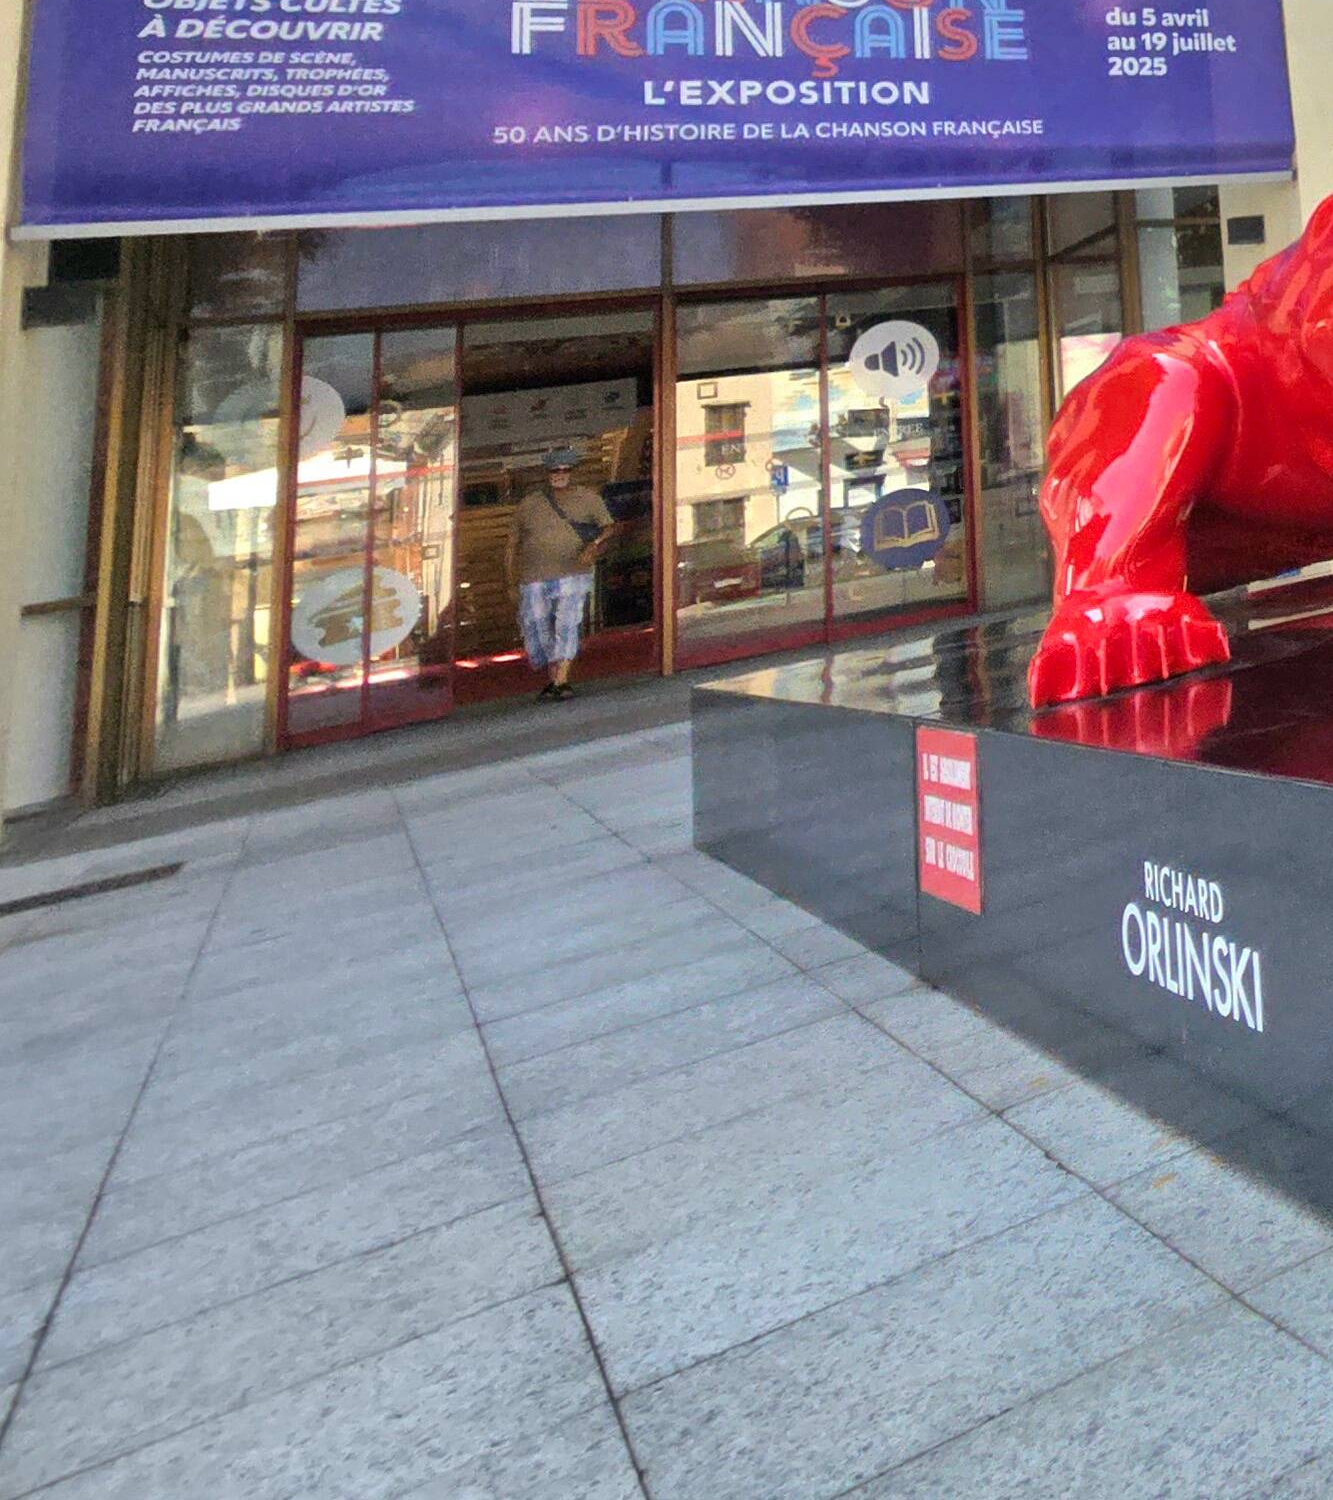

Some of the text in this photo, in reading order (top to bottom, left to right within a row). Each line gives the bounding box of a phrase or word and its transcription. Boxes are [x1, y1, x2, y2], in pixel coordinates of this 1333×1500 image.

[1105, 7, 1210, 27] du 5 avril
[137, 14, 384, 41] À DÉCOUVRIR
[1107, 32, 1237, 56] au 19 juillet
[137, 50, 357, 66] COSTUMES DE SCÈNE,
[1108, 56, 1168, 76] 2025
[135, 66, 391, 82] MANUSCRITS, TROPHÉES,
[133, 84, 388, 99] AFFICHES, DISQUES D'OR
[643, 79, 930, 106] L'EXPOSITION
[133, 99, 415, 115] DES PLUS GRANDS ARTISTES
[131, 117, 242, 135] FRANÇAIS
[492, 119, 1043, 144] 50 ANS D'HISTOIRE DE LA CHANSON FRANÇAISE
[1143, 861, 1225, 923] RICHARD
[1121, 902, 1264, 1033] ORLINSKI
